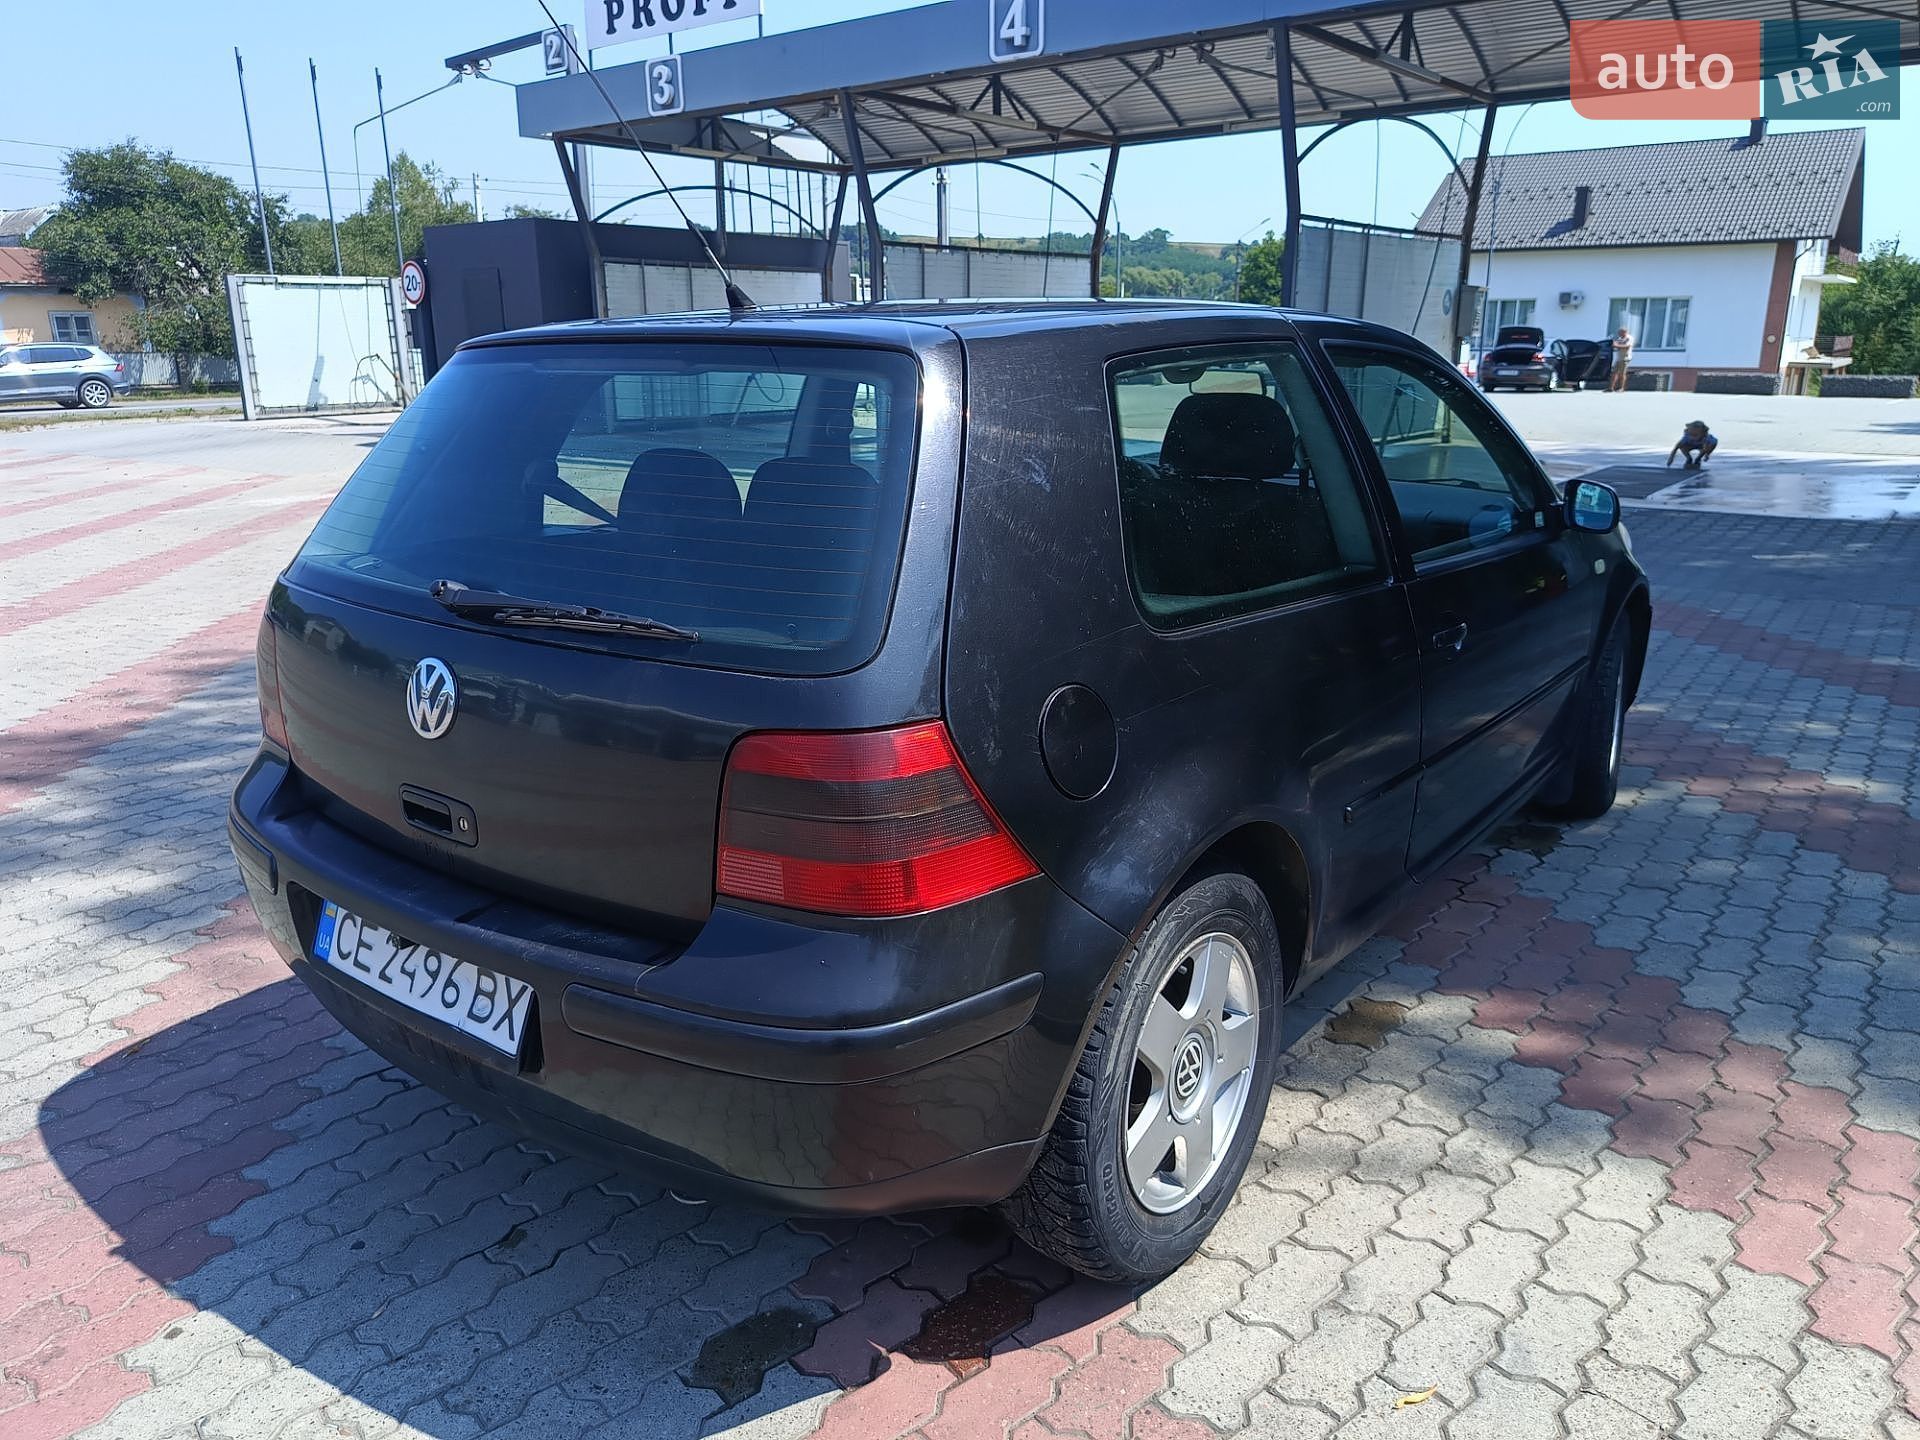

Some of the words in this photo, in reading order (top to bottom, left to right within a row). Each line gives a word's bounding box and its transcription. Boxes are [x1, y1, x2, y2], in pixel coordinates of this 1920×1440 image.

[604, 0, 738, 35] PRO
[1000, 0, 1031, 46] 4
[546, 34, 562, 66] 2
[652, 65, 675, 105] 3
[318, 932, 330, 951] UA
